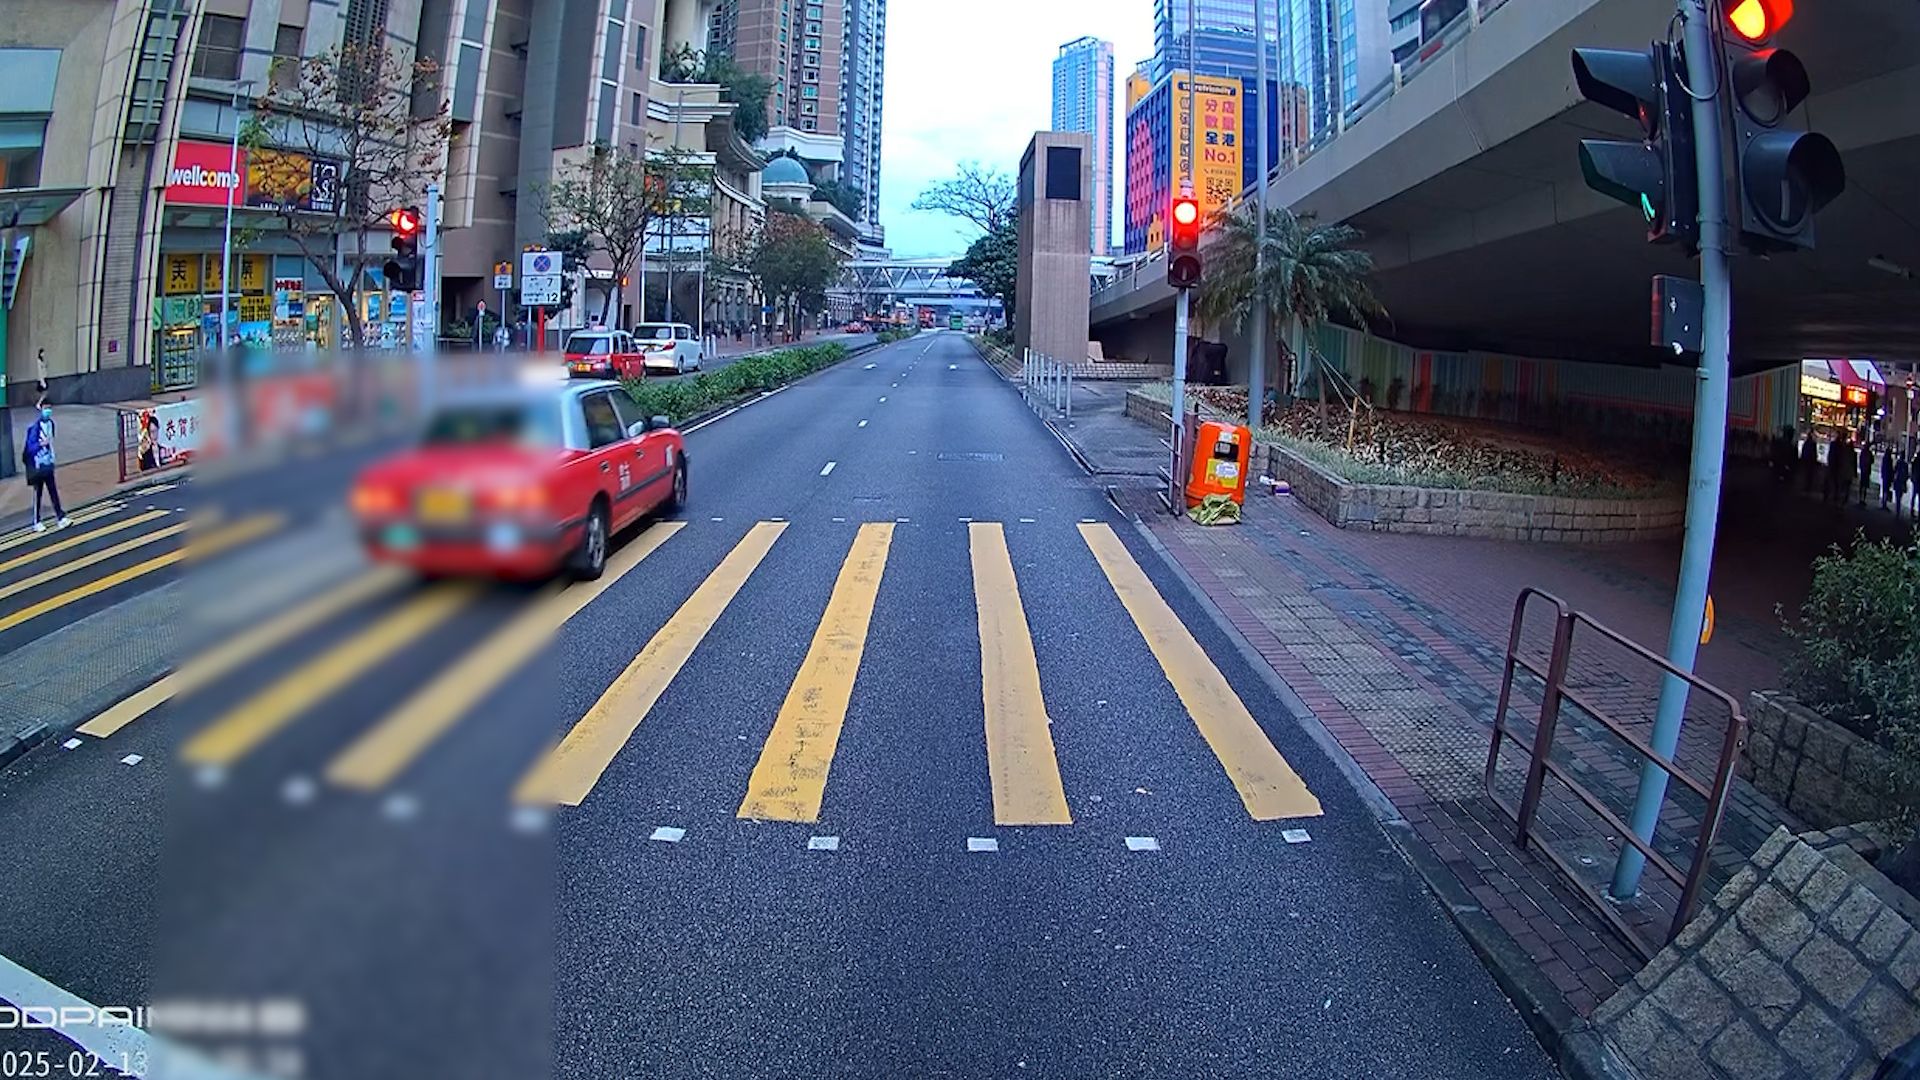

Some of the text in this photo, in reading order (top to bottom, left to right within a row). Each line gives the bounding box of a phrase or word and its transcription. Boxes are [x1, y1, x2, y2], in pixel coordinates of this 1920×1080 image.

[1206, 99, 1235, 114] 分店
[1206, 131, 1235, 147] 全港
[1205, 148, 1235, 164] No.1
[171, 165, 240, 189] wellcome
[172, 259, 187, 281] 美
[547, 277, 553, 287] 7
[547, 292, 558, 302] 12
